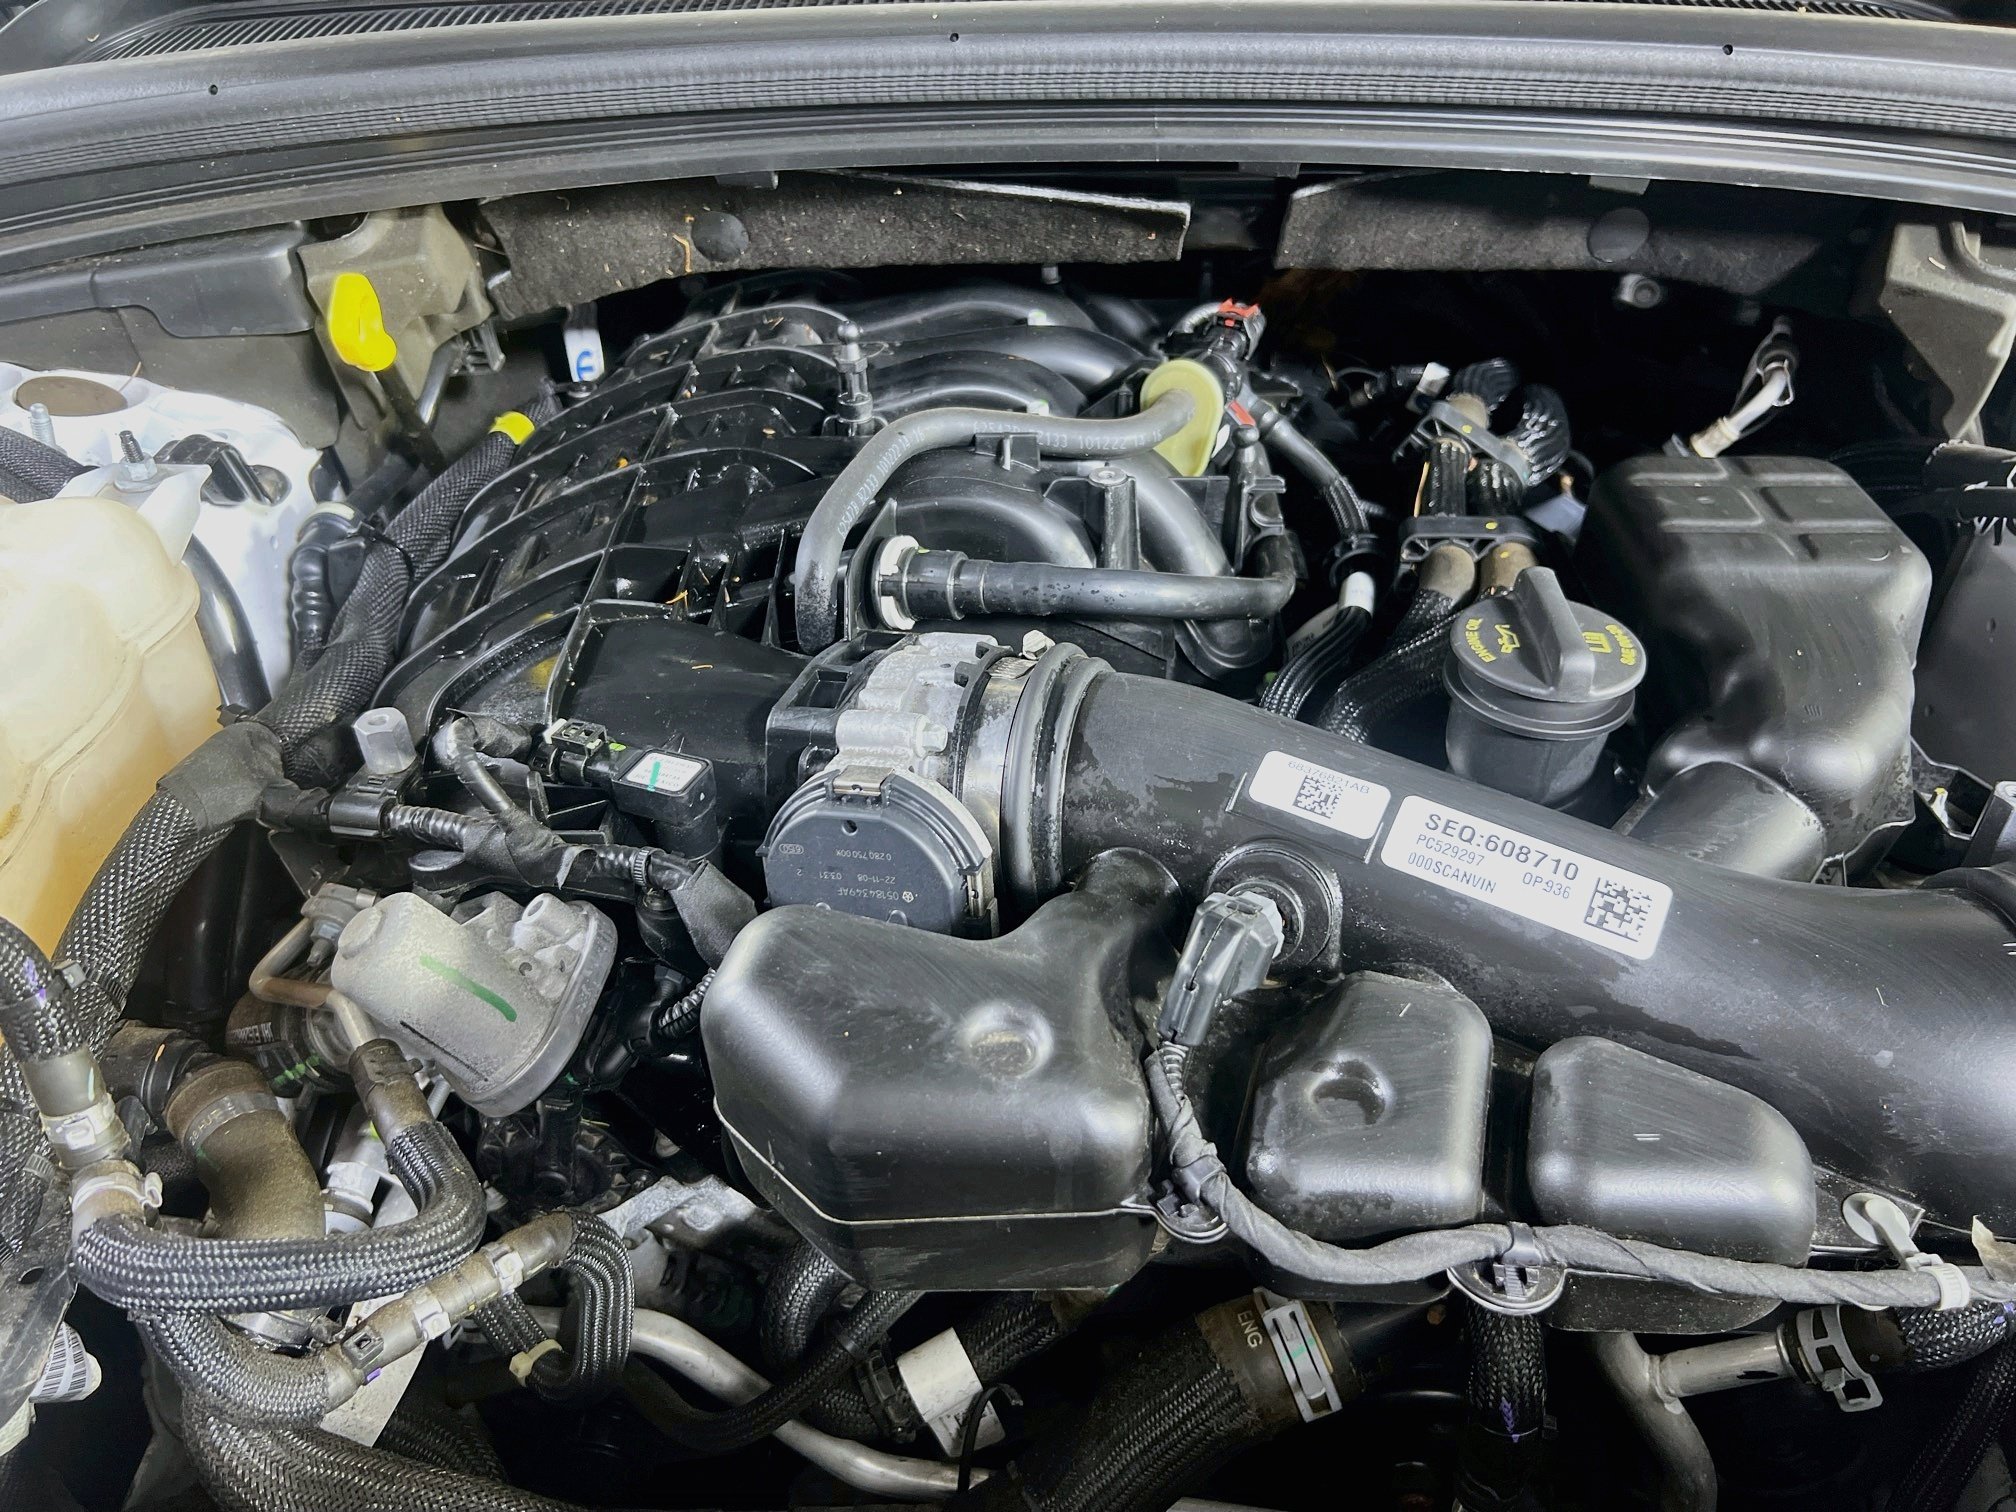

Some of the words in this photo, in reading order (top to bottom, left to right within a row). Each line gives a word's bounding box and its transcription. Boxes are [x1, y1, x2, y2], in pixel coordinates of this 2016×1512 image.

[1416, 833, 1485, 866] PC529297
[1424, 813, 1579, 881] SEQ:608710
[1407, 851, 1497, 894] 000SCANVIN
[837, 887, 899, 901] 05184349AF
[1237, 1310, 1263, 1348] ENG
